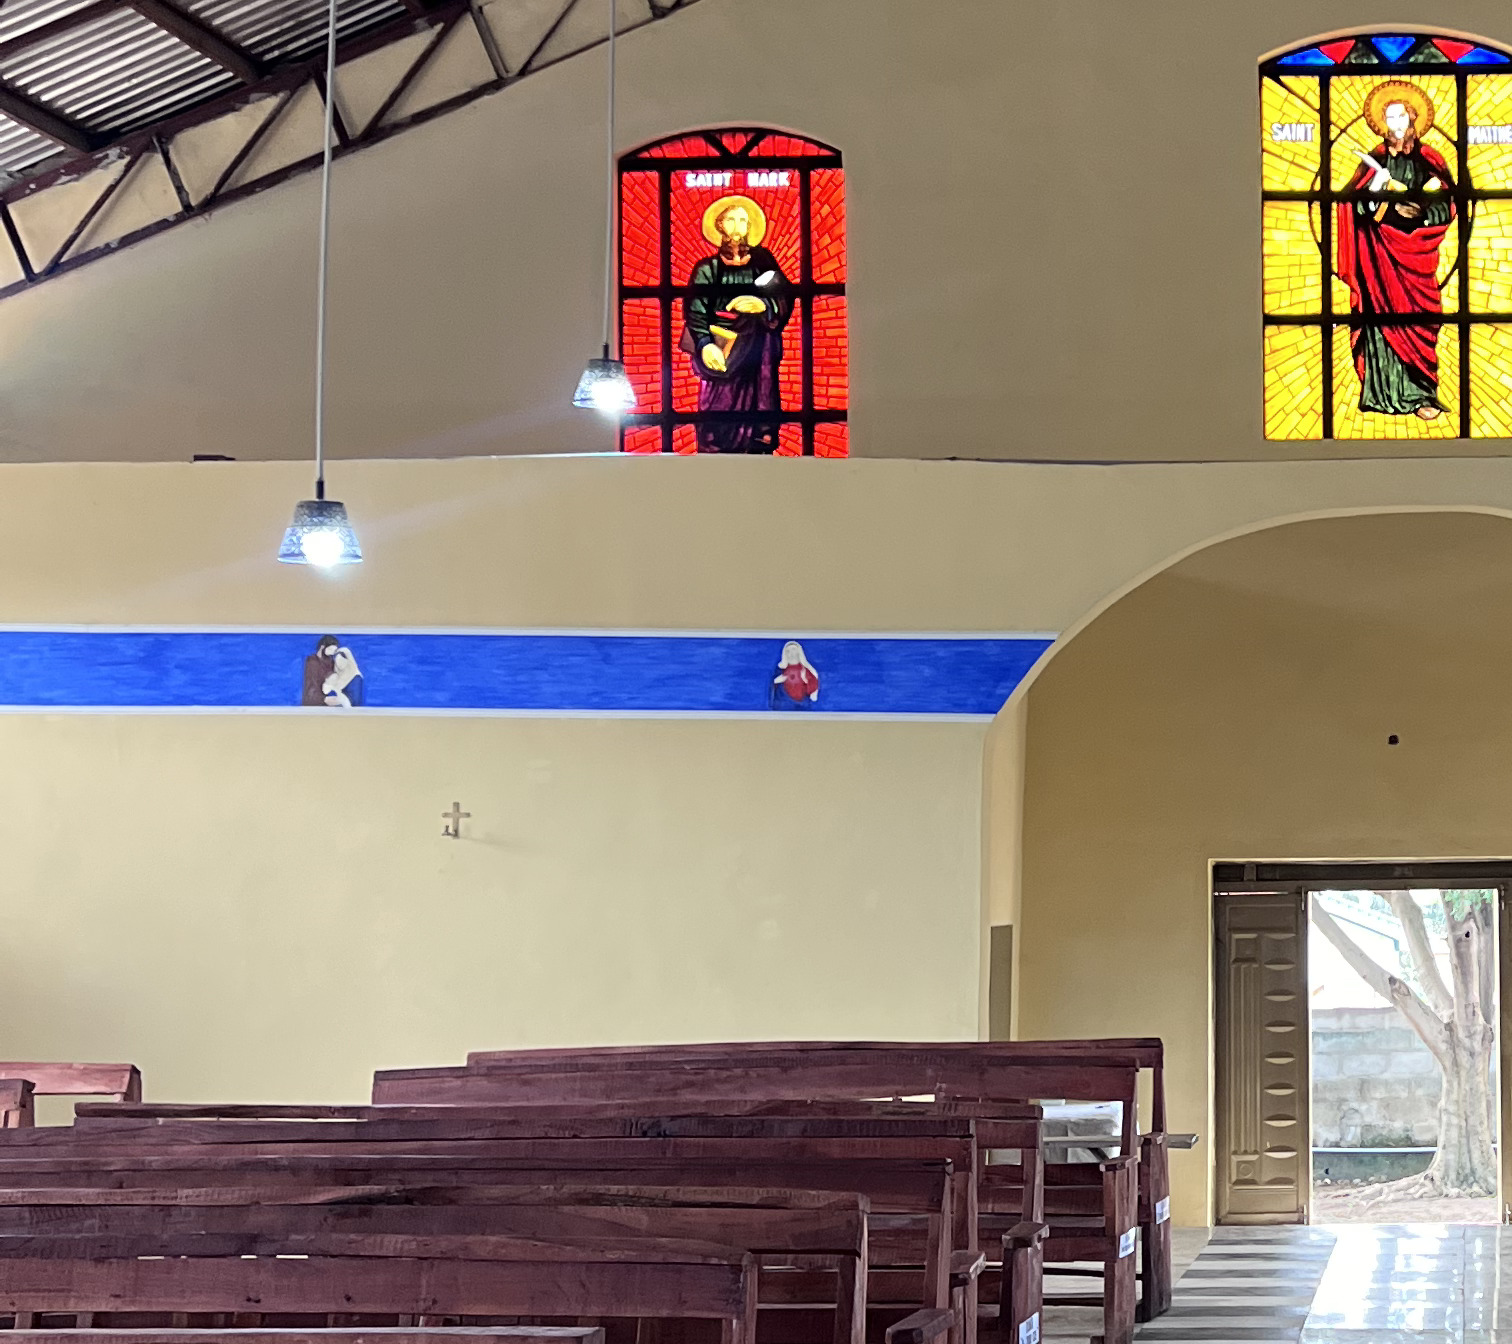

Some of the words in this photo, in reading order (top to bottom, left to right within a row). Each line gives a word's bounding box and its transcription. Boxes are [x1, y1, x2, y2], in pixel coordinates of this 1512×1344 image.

[1271, 122, 1315, 142] SAINT
[686, 172, 732, 187] SAINT
[748, 171, 791, 187] MARK
